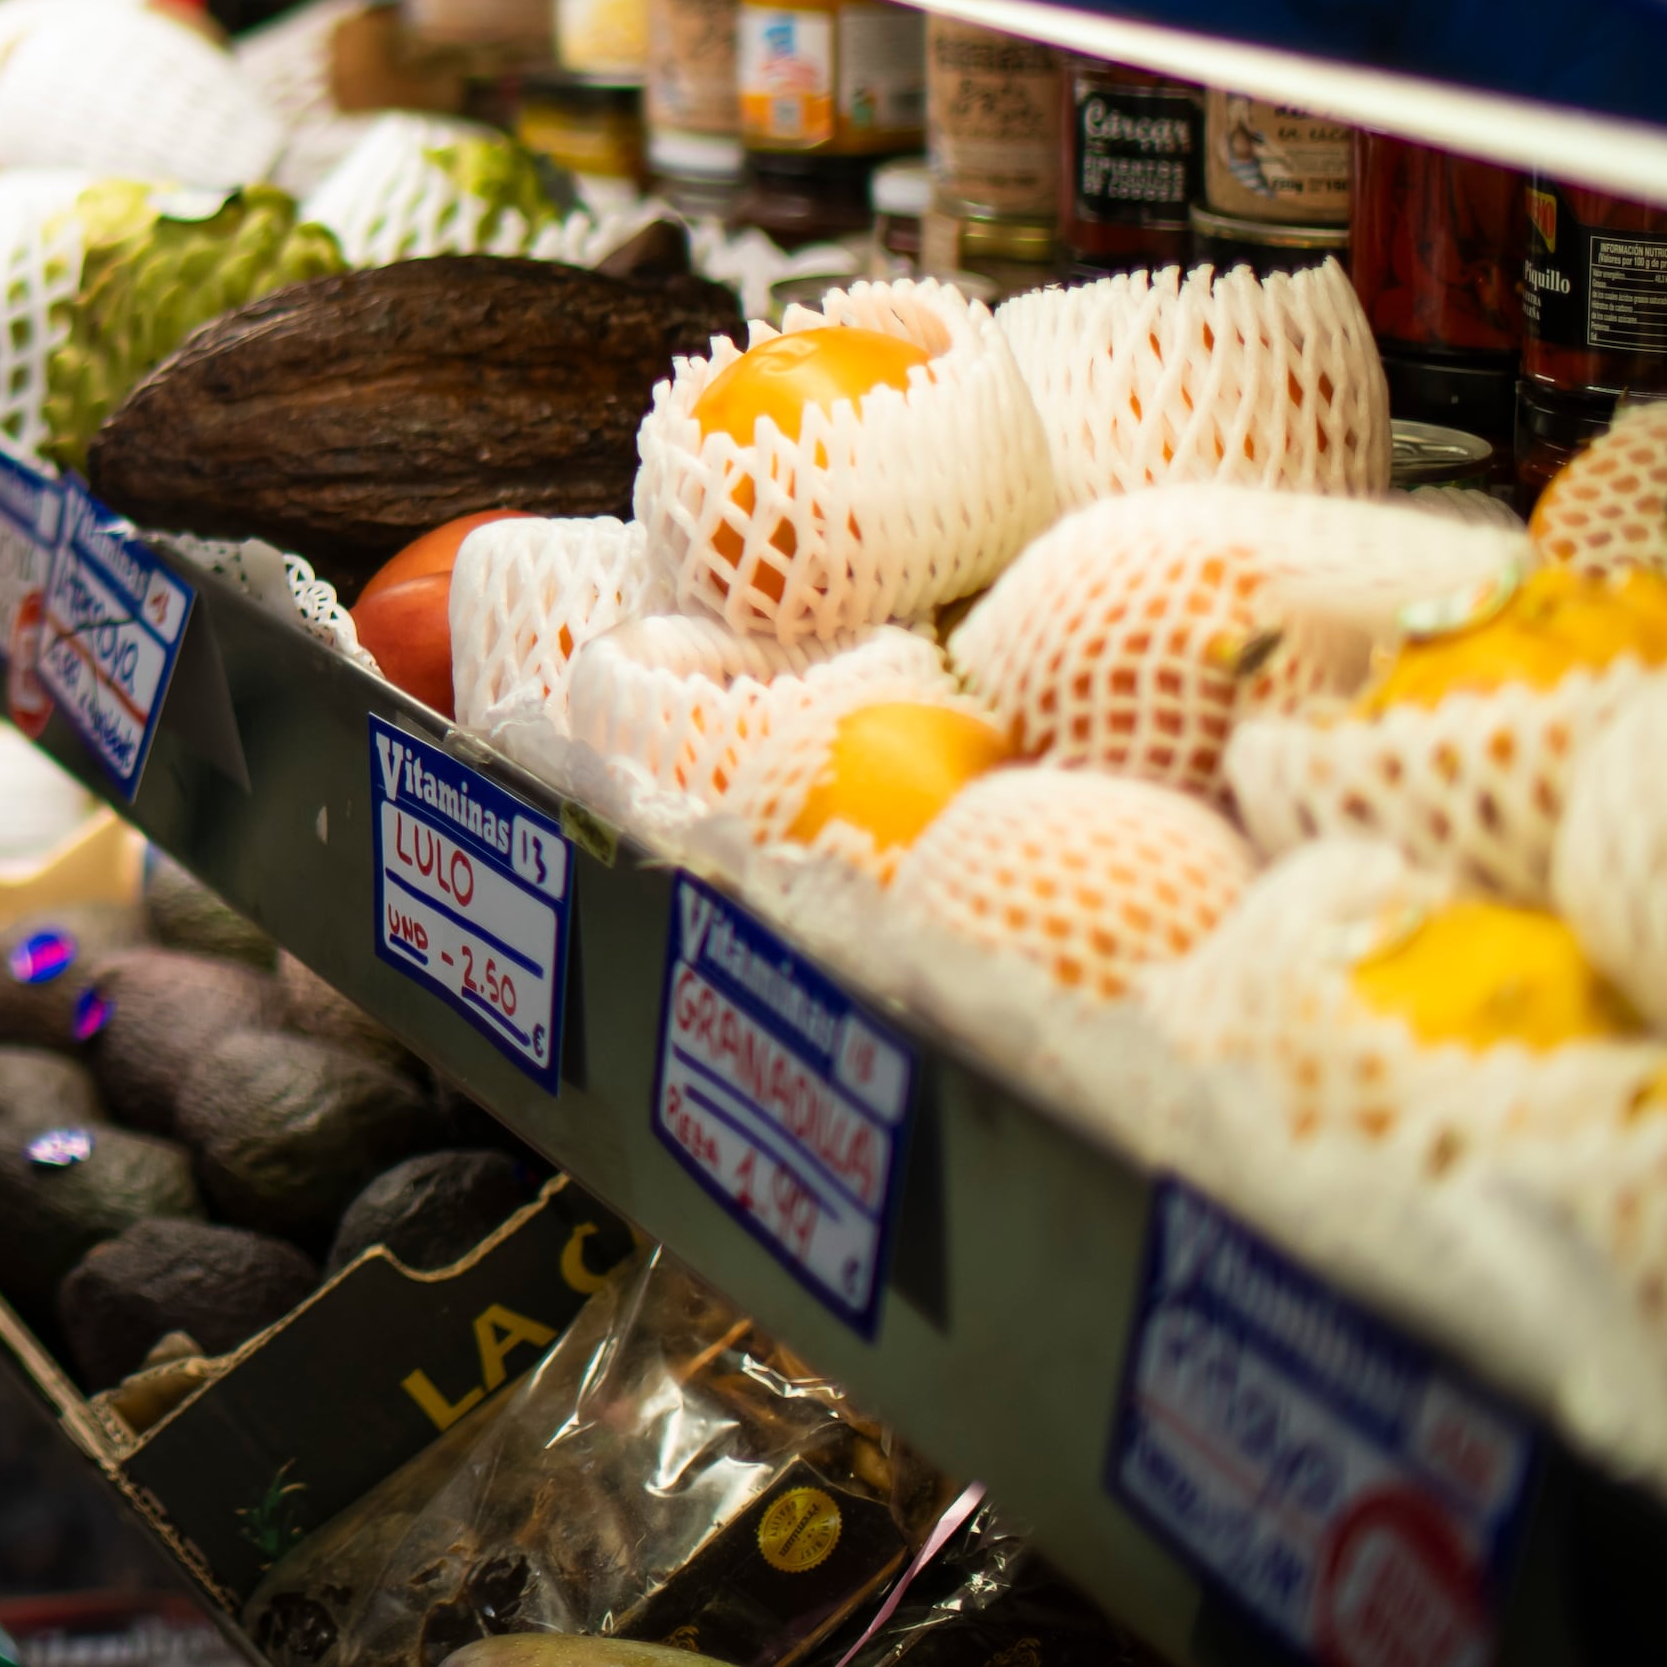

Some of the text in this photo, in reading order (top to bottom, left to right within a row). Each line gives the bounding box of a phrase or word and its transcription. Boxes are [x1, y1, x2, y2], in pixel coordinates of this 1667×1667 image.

[1524, 259, 1571, 294] Piquillo
[376, 732, 547, 884] Vitaminas 13
[396, 811, 475, 907] LULO
[461, 945, 517, 1016] 2.50
[679, 881, 833, 1056] Vitaminas
[674, 968, 876, 1205] GRANADILLA
[400, 1303, 559, 1431] LA
